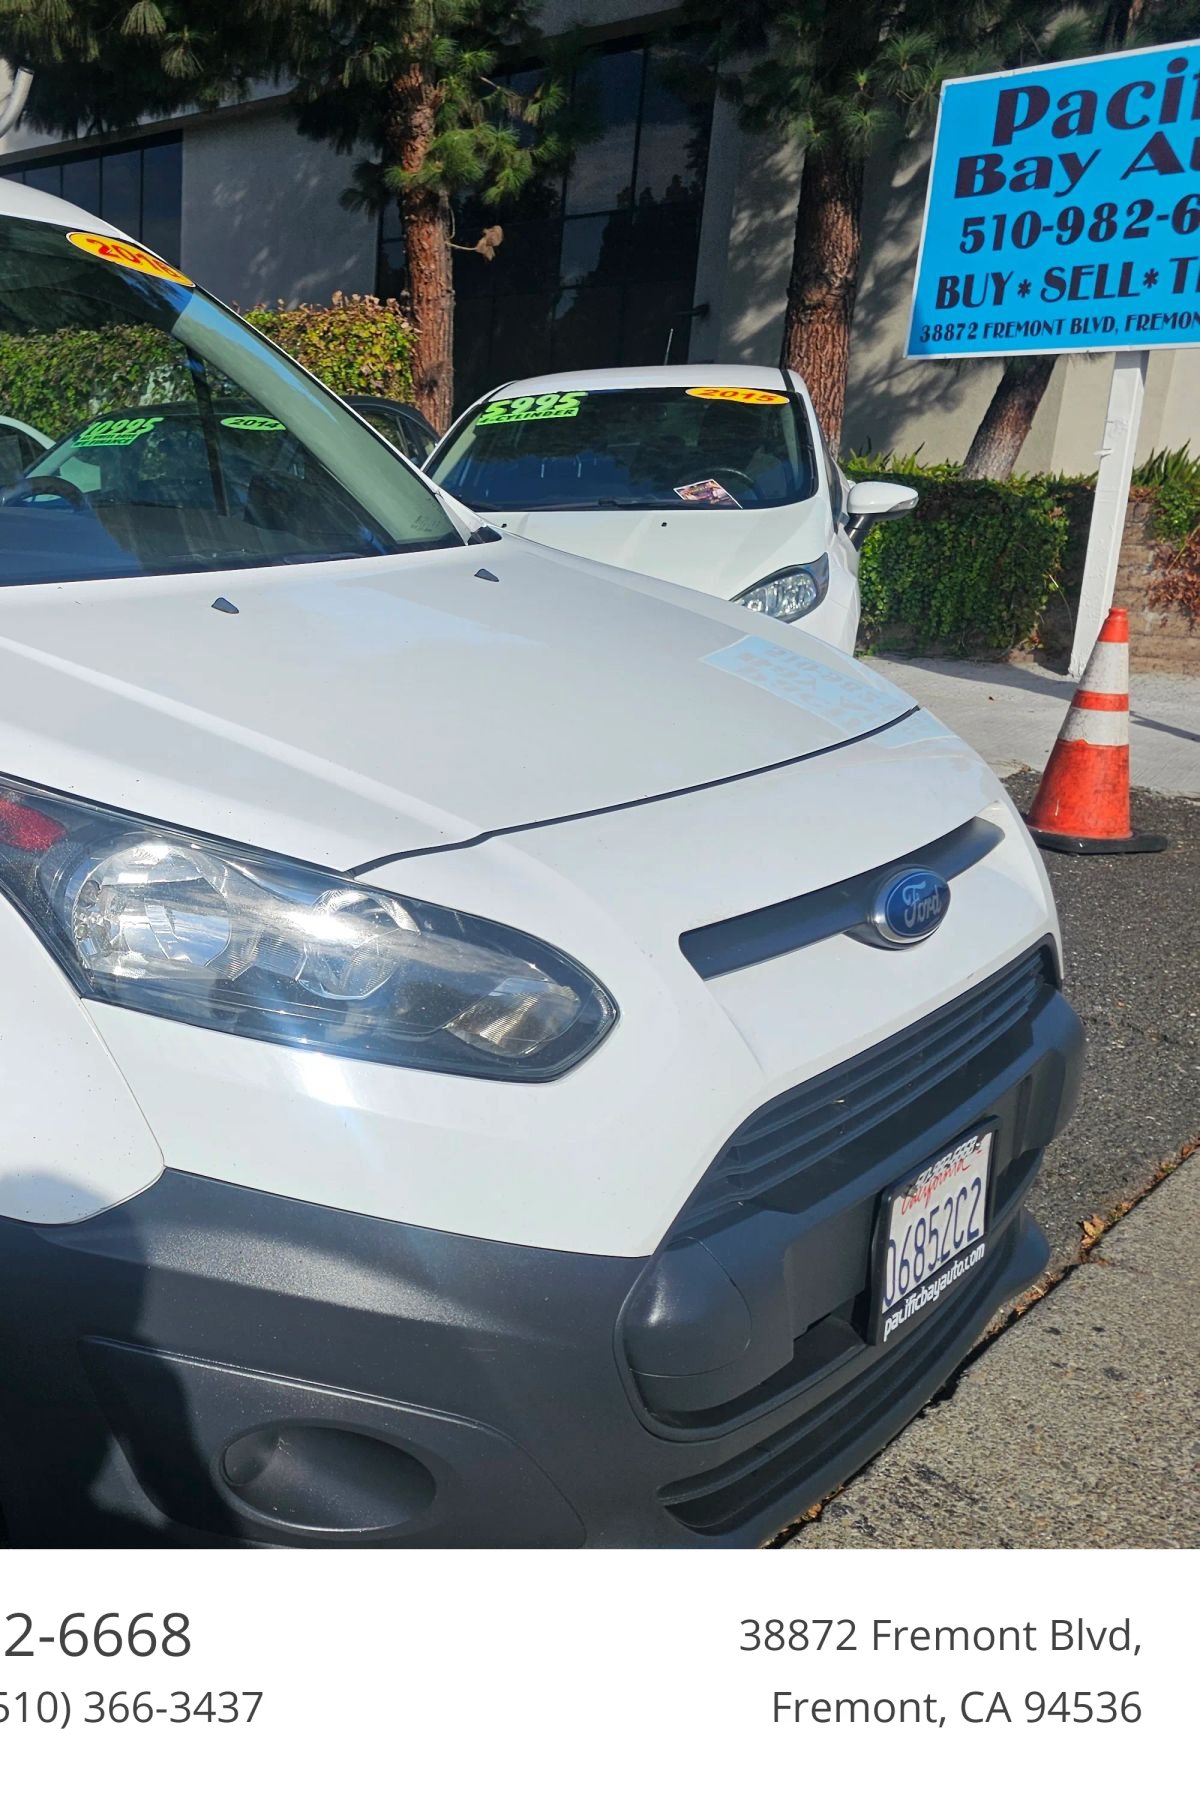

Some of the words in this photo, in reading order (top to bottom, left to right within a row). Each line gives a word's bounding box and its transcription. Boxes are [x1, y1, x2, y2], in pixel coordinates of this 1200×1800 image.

[954, 149, 1102, 198] Bay
[935, 271, 1013, 309] BUY
[1041, 262, 1140, 303] SELL
[1169, 256, 1200, 295] T
[920, 321, 977, 343] 38872
[983, 318, 1066, 339] FREMONT
[481, 392, 588, 419] 5995
[699, 389, 778, 402] 2015
[229, 419, 279, 428] 2014
[902, 881, 941, 928] Ford
[883, 1243, 986, 1342] pacificbayauto.com
